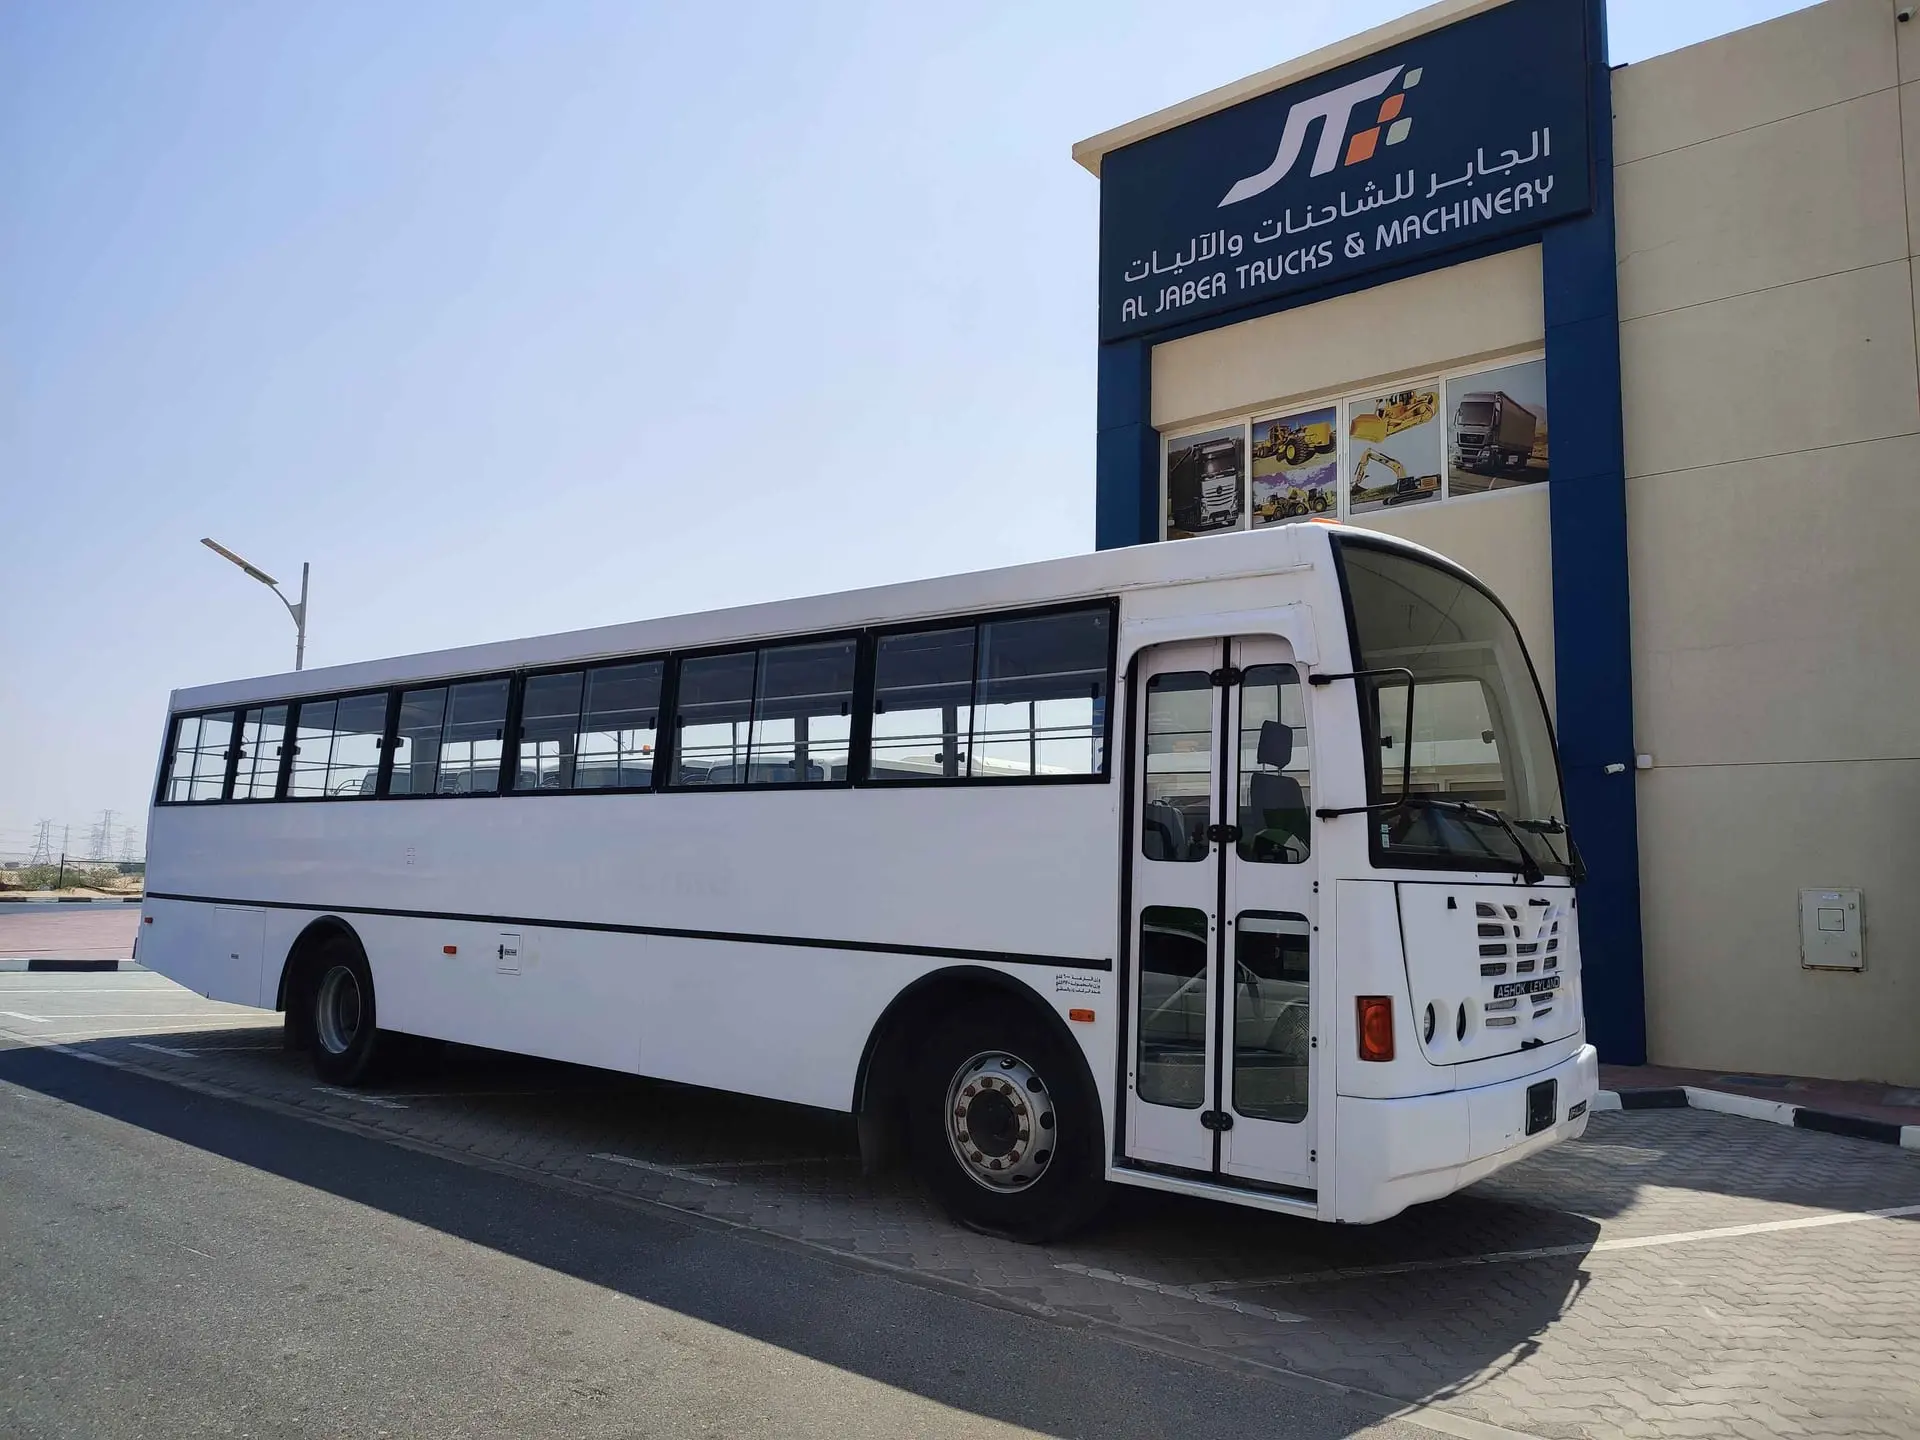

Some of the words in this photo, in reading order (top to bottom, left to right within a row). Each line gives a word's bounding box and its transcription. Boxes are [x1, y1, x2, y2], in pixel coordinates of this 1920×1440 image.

[1425, 127, 1550, 199] الجابر
[1253, 169, 1415, 244] للشاحنات
[1122, 295, 1148, 322] AL
[1155, 272, 1227, 313] JABER
[1235, 240, 1334, 290] TRUCKS
[1344, 231, 1366, 259] &
[1375, 174, 1554, 251] MACHINERY
[1124, 229, 1243, 283] والآليات
[1497, 982, 1526, 998] ASHOK
